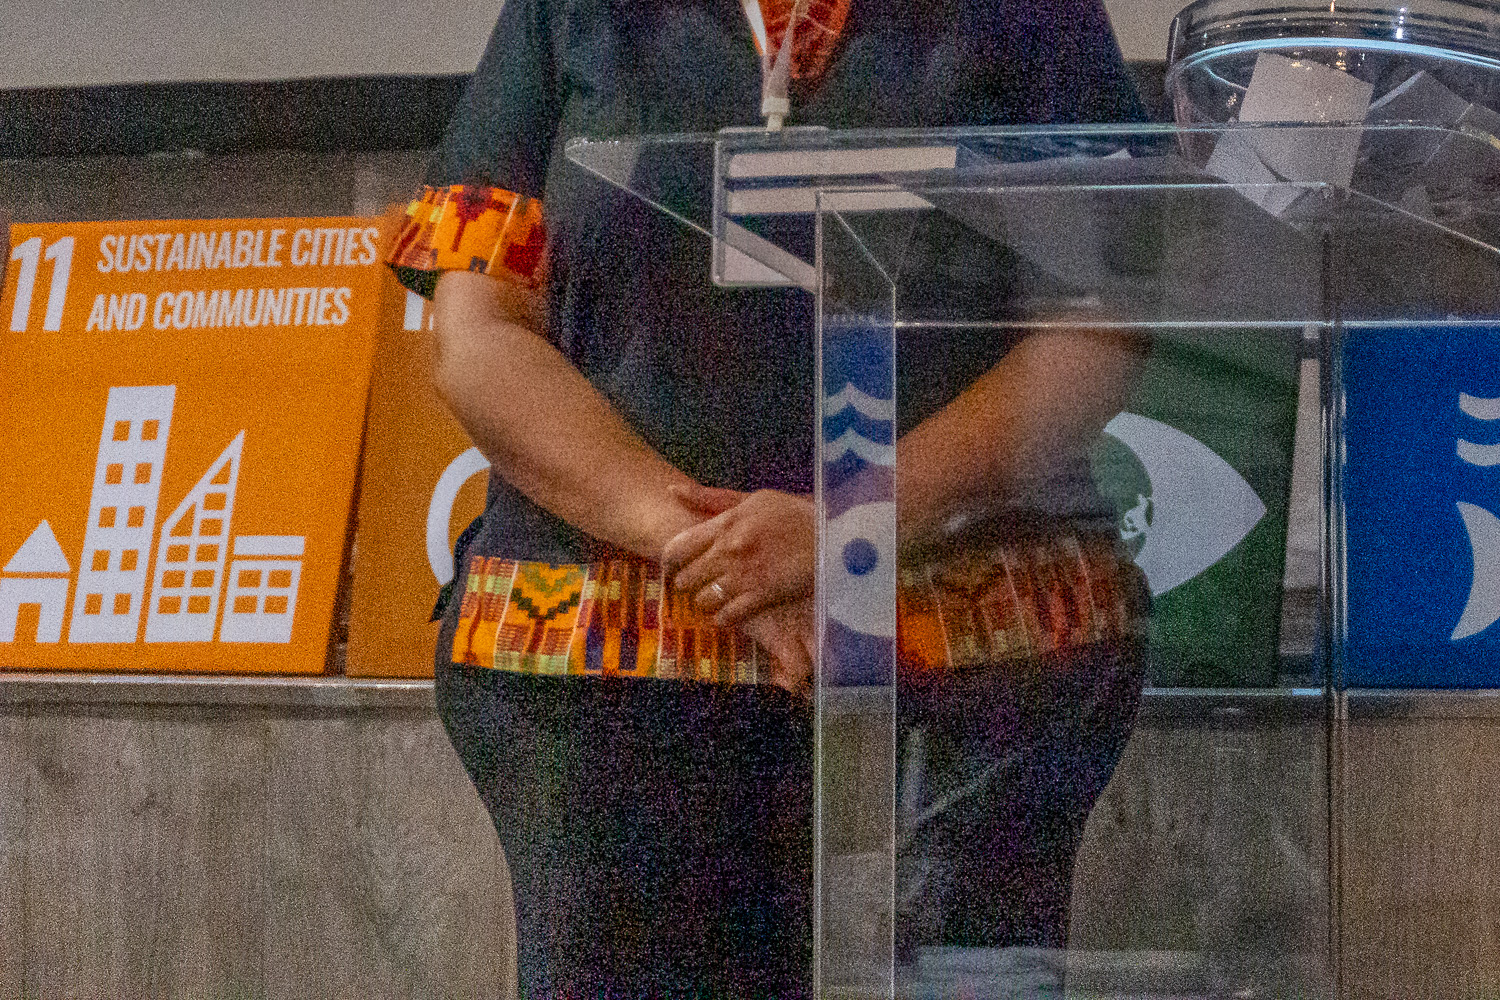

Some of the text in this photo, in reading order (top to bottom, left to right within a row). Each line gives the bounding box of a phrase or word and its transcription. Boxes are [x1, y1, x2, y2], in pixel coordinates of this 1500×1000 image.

[97, 227, 379, 273] SUSTAINABLE CITIES
[10, 236, 74, 332] 11
[87, 287, 351, 332] AND COMMUNITIES
